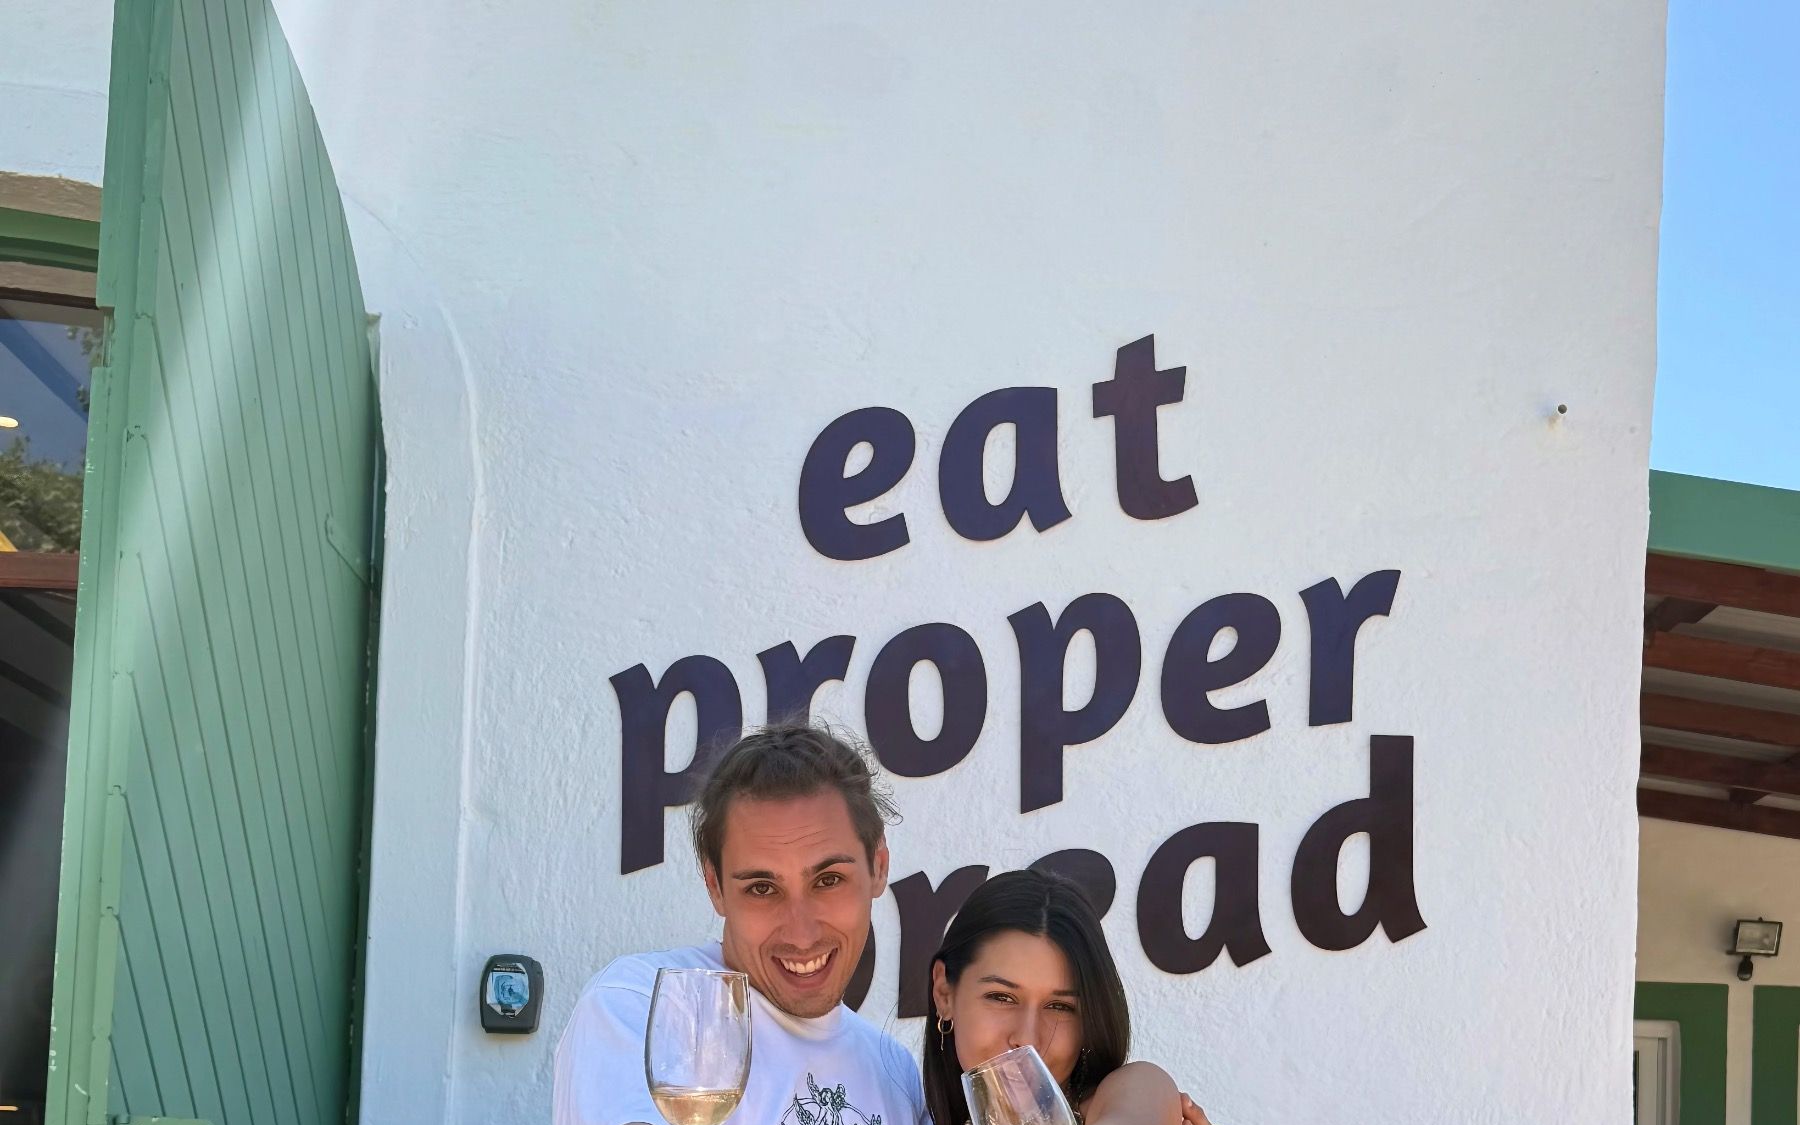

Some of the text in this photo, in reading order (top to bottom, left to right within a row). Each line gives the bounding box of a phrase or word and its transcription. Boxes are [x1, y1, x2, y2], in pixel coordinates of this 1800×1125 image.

[798, 333, 1200, 562] eat
[608, 569, 1402, 876] proper
[844, 734, 1428, 1021] rad
